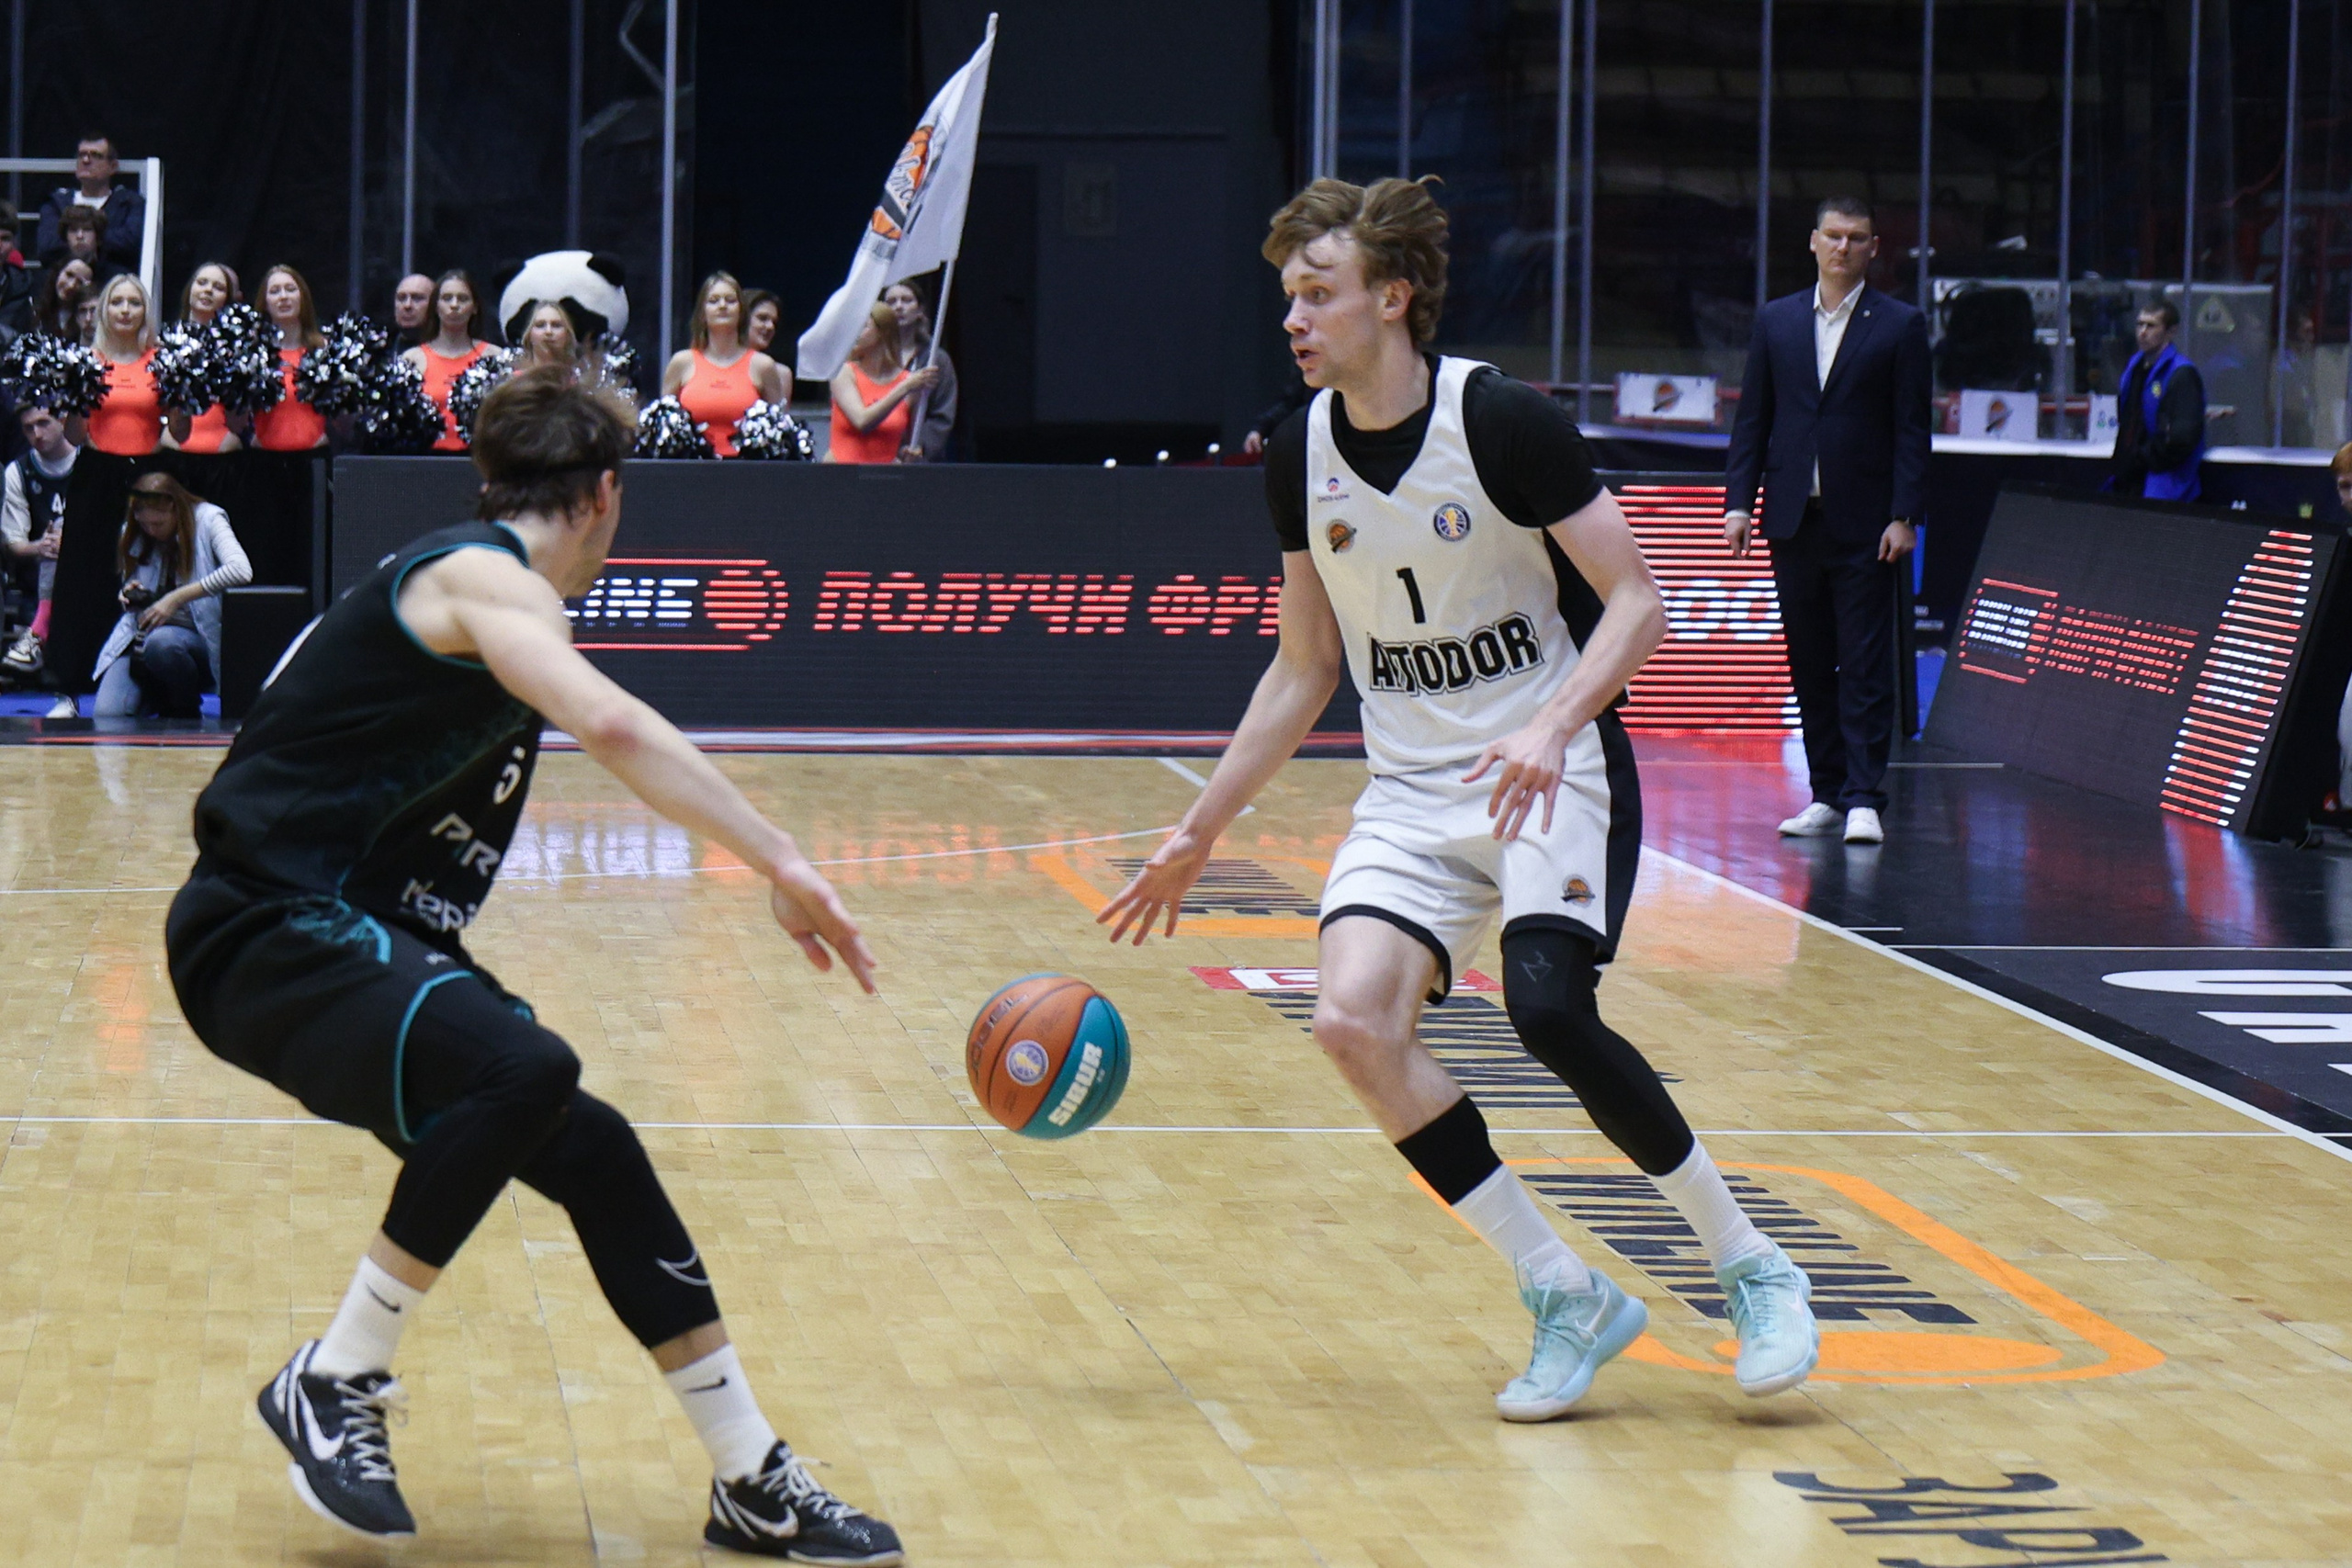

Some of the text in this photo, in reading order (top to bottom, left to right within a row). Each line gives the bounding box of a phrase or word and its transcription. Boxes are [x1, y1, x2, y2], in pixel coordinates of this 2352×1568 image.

[1396, 567, 1426, 624] 1
[1368, 613, 1544, 697] ATODOR
[1047, 1041, 1102, 1127] SIBUR
